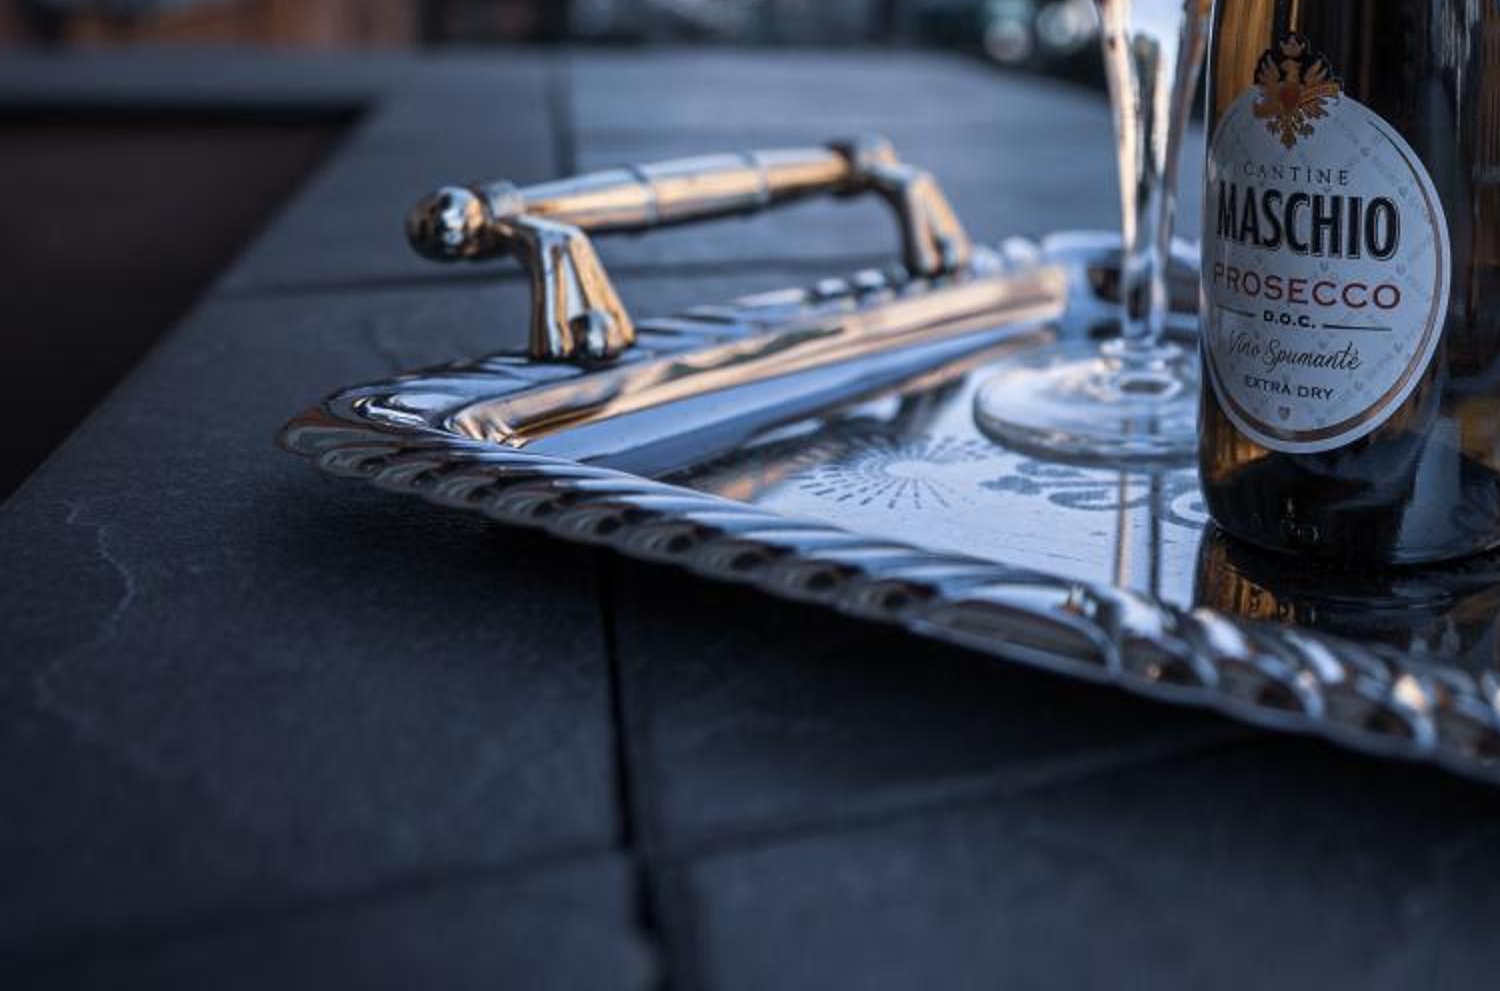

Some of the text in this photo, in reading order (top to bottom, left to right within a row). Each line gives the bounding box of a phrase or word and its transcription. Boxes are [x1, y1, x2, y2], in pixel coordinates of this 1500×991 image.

[1243, 161, 1349, 186] CANTINE
[1216, 181, 1400, 262] MASCHIO
[1212, 263, 1401, 310] PROSECCO
[1263, 311, 1315, 329] D.O.C.
[1244, 375, 1334, 400] EXTRA DRY
